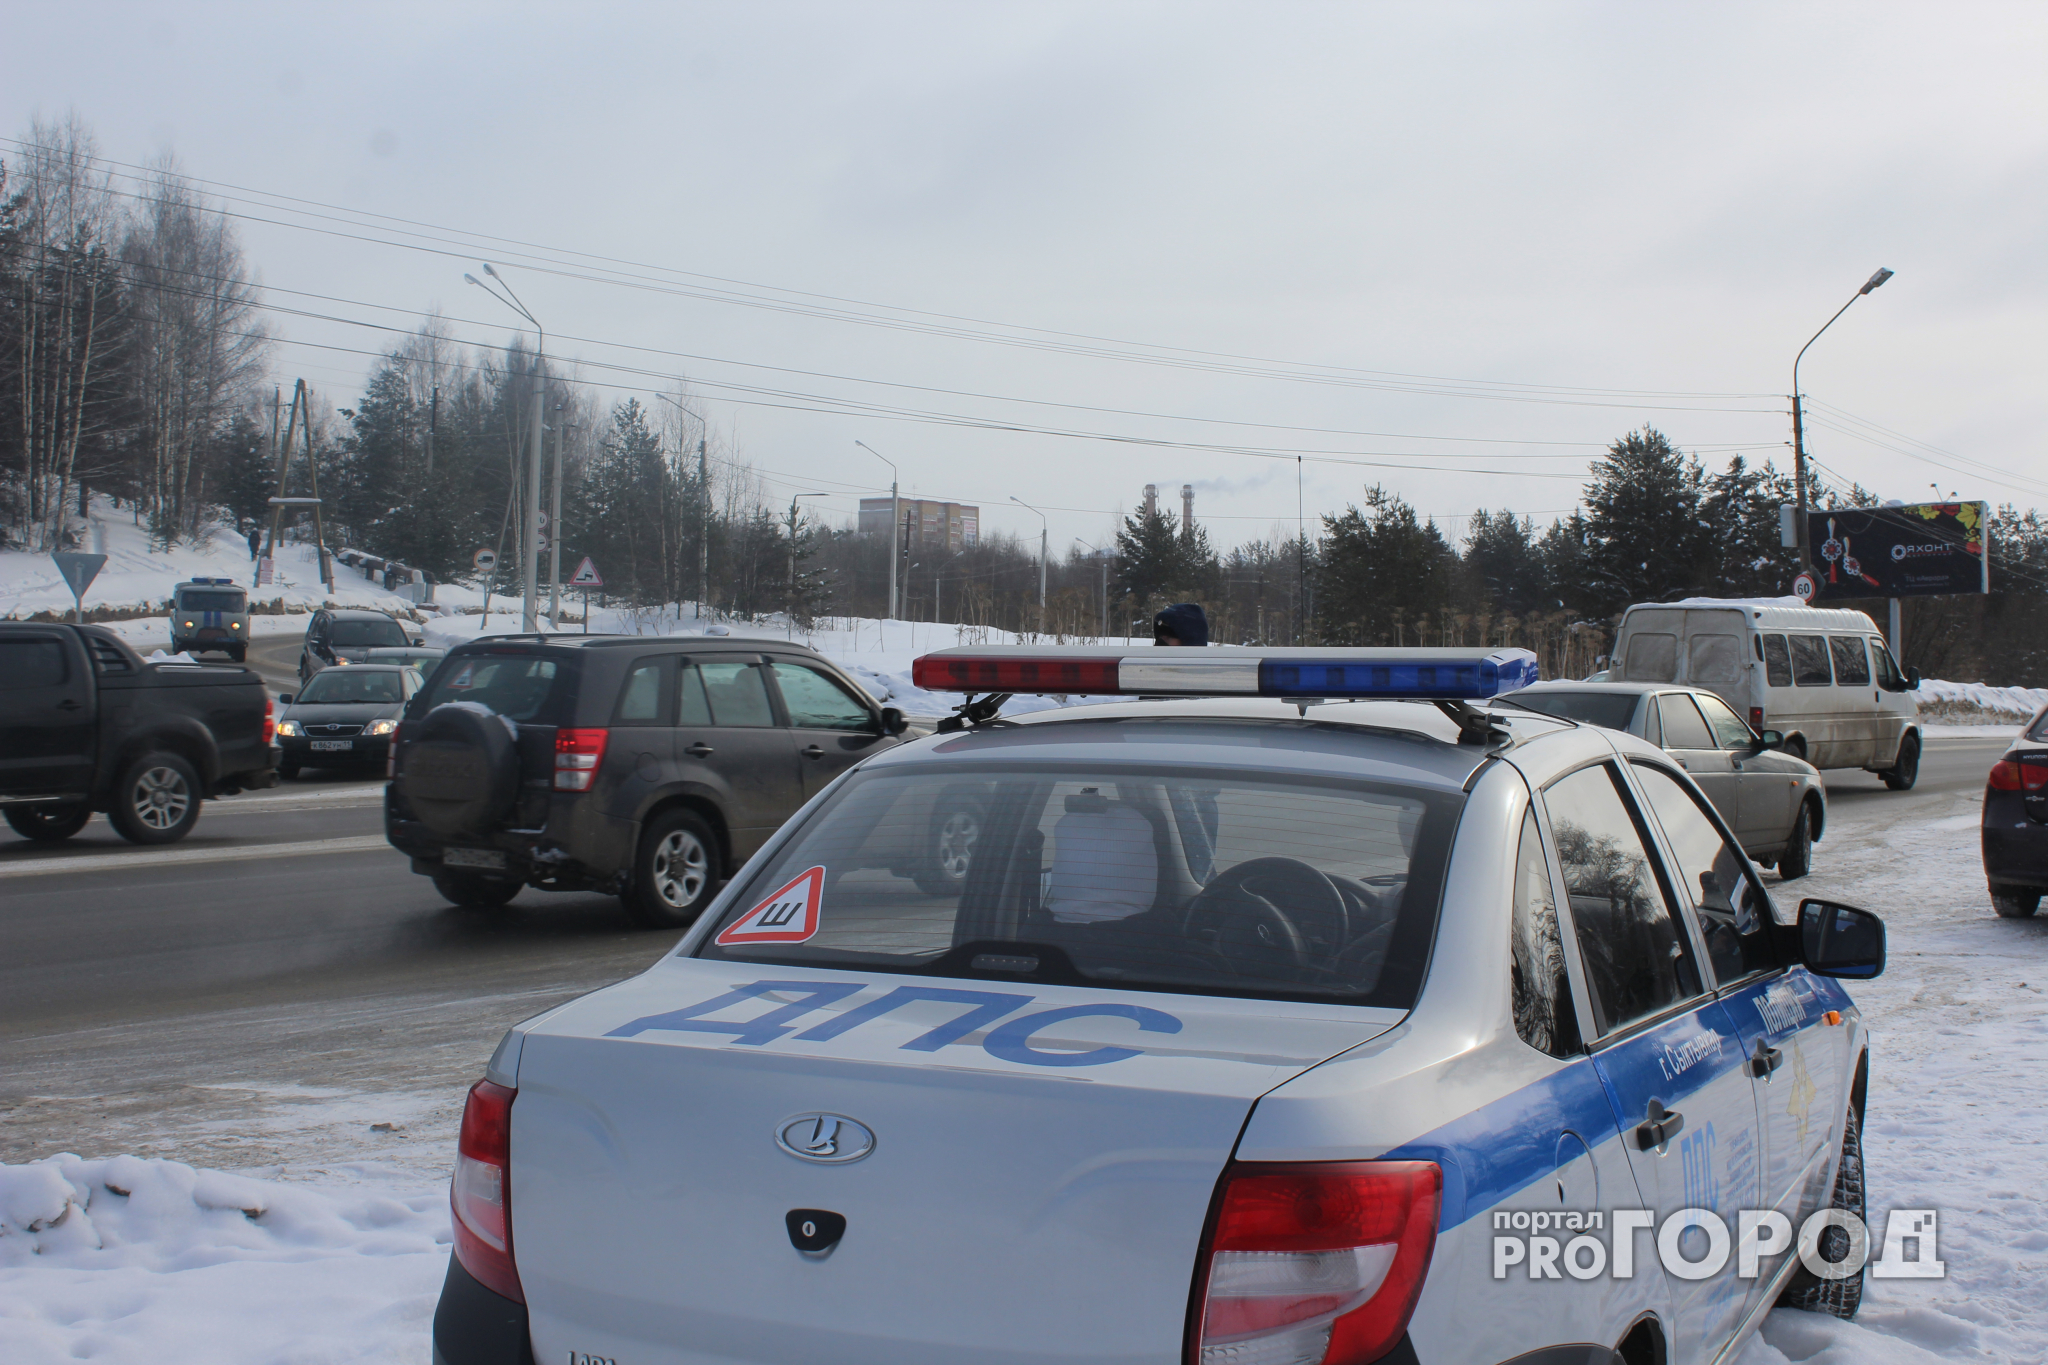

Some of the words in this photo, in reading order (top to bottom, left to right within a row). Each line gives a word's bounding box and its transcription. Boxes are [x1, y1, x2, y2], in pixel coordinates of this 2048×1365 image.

[1906, 544, 1952, 553] ЯХОНТ
[1797, 583, 1810, 595] 60
[756, 902, 803, 927] Ш
[601, 979, 1183, 1067] ДПС
[1664, 1027, 1723, 1076] Сыктывкар
[1680, 1120, 1719, 1245] ДПС
